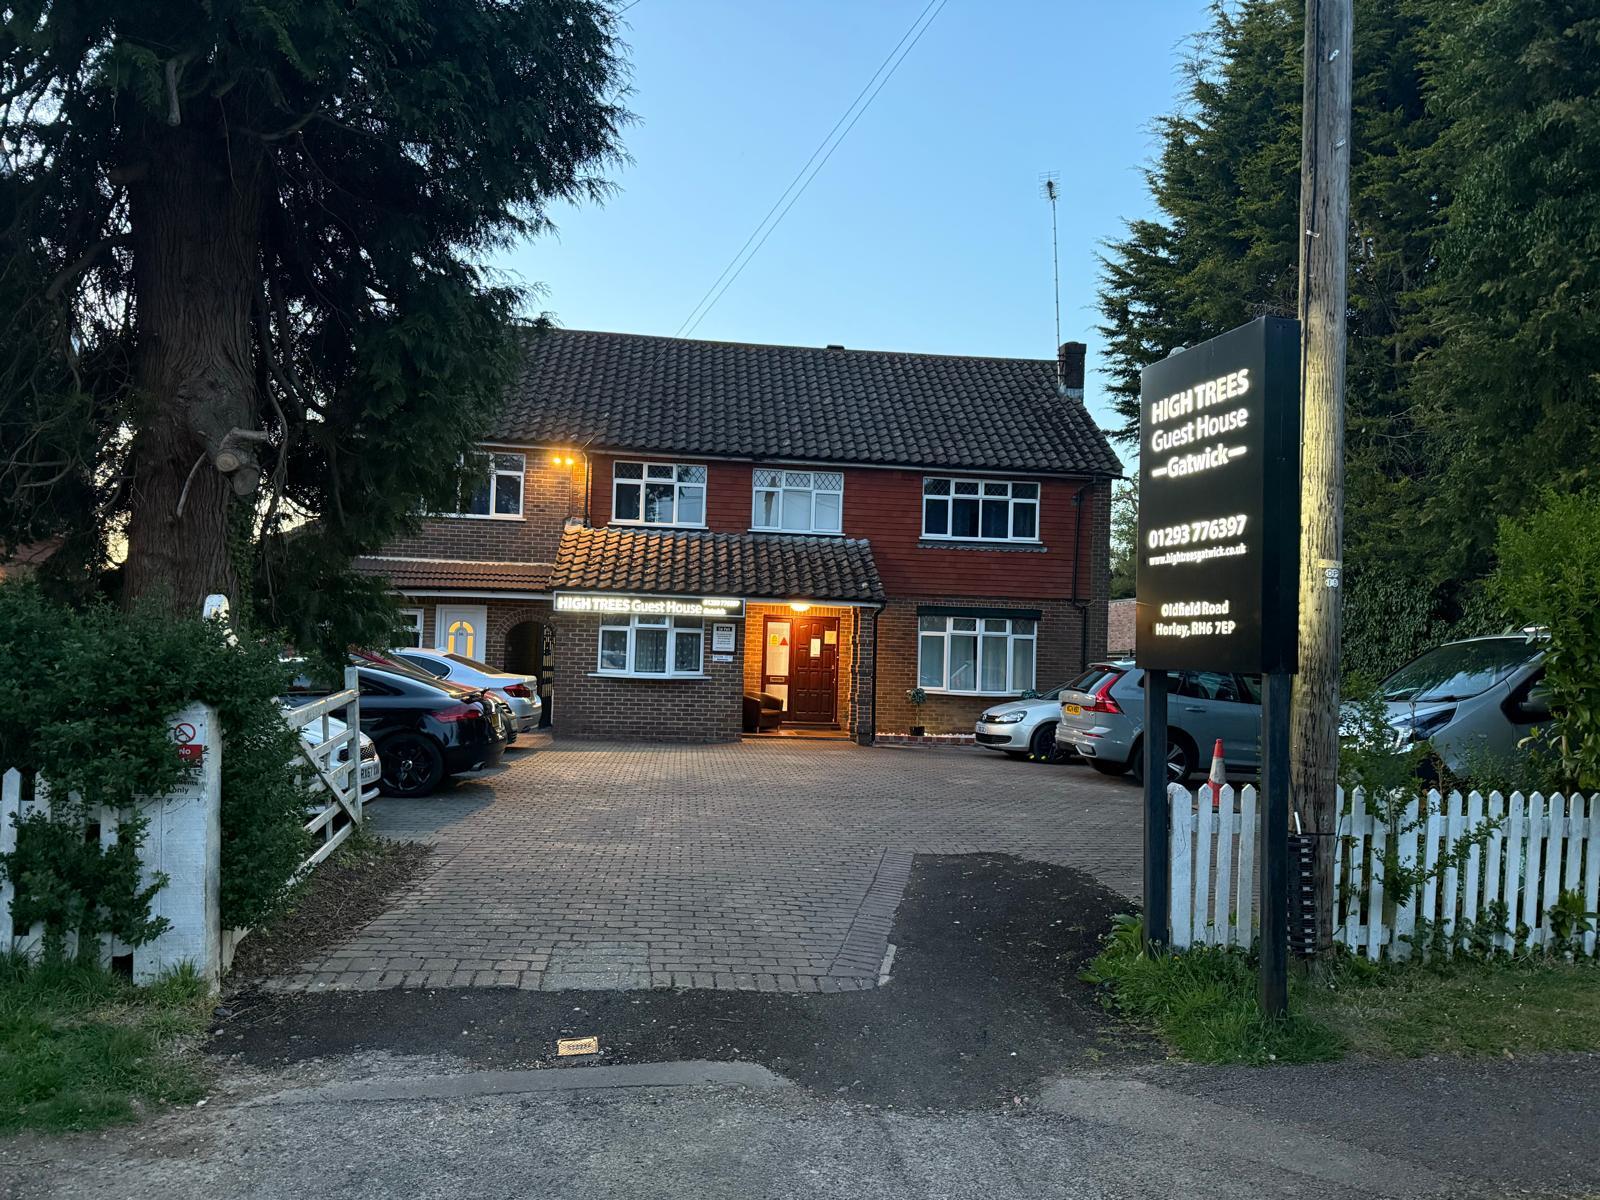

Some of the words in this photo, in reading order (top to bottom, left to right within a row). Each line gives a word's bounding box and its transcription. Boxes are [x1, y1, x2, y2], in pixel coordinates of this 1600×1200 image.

[1151, 387, 1195, 424] HIGH
[1195, 369, 1249, 409] TREES
[1152, 422, 1195, 452] Guest
[1195, 408, 1248, 440] House
[1148, 524, 1192, 548] 01293
[1191, 515, 1247, 542] 776397
[1149, 543, 1246, 565] www.hightreesgatwick.co.uk
[557, 596, 592, 610] HIGH
[592, 597, 631, 611] TREES
[631, 600, 665, 612] Guest
[665, 601, 702, 613] House
[1161, 602, 1201, 617] Oldfield
[1202, 600, 1229, 615] Road
[1156, 622, 1191, 638] Horley,
[1191, 622, 1213, 635] RH6
[1215, 621, 1235, 634] 7EP
